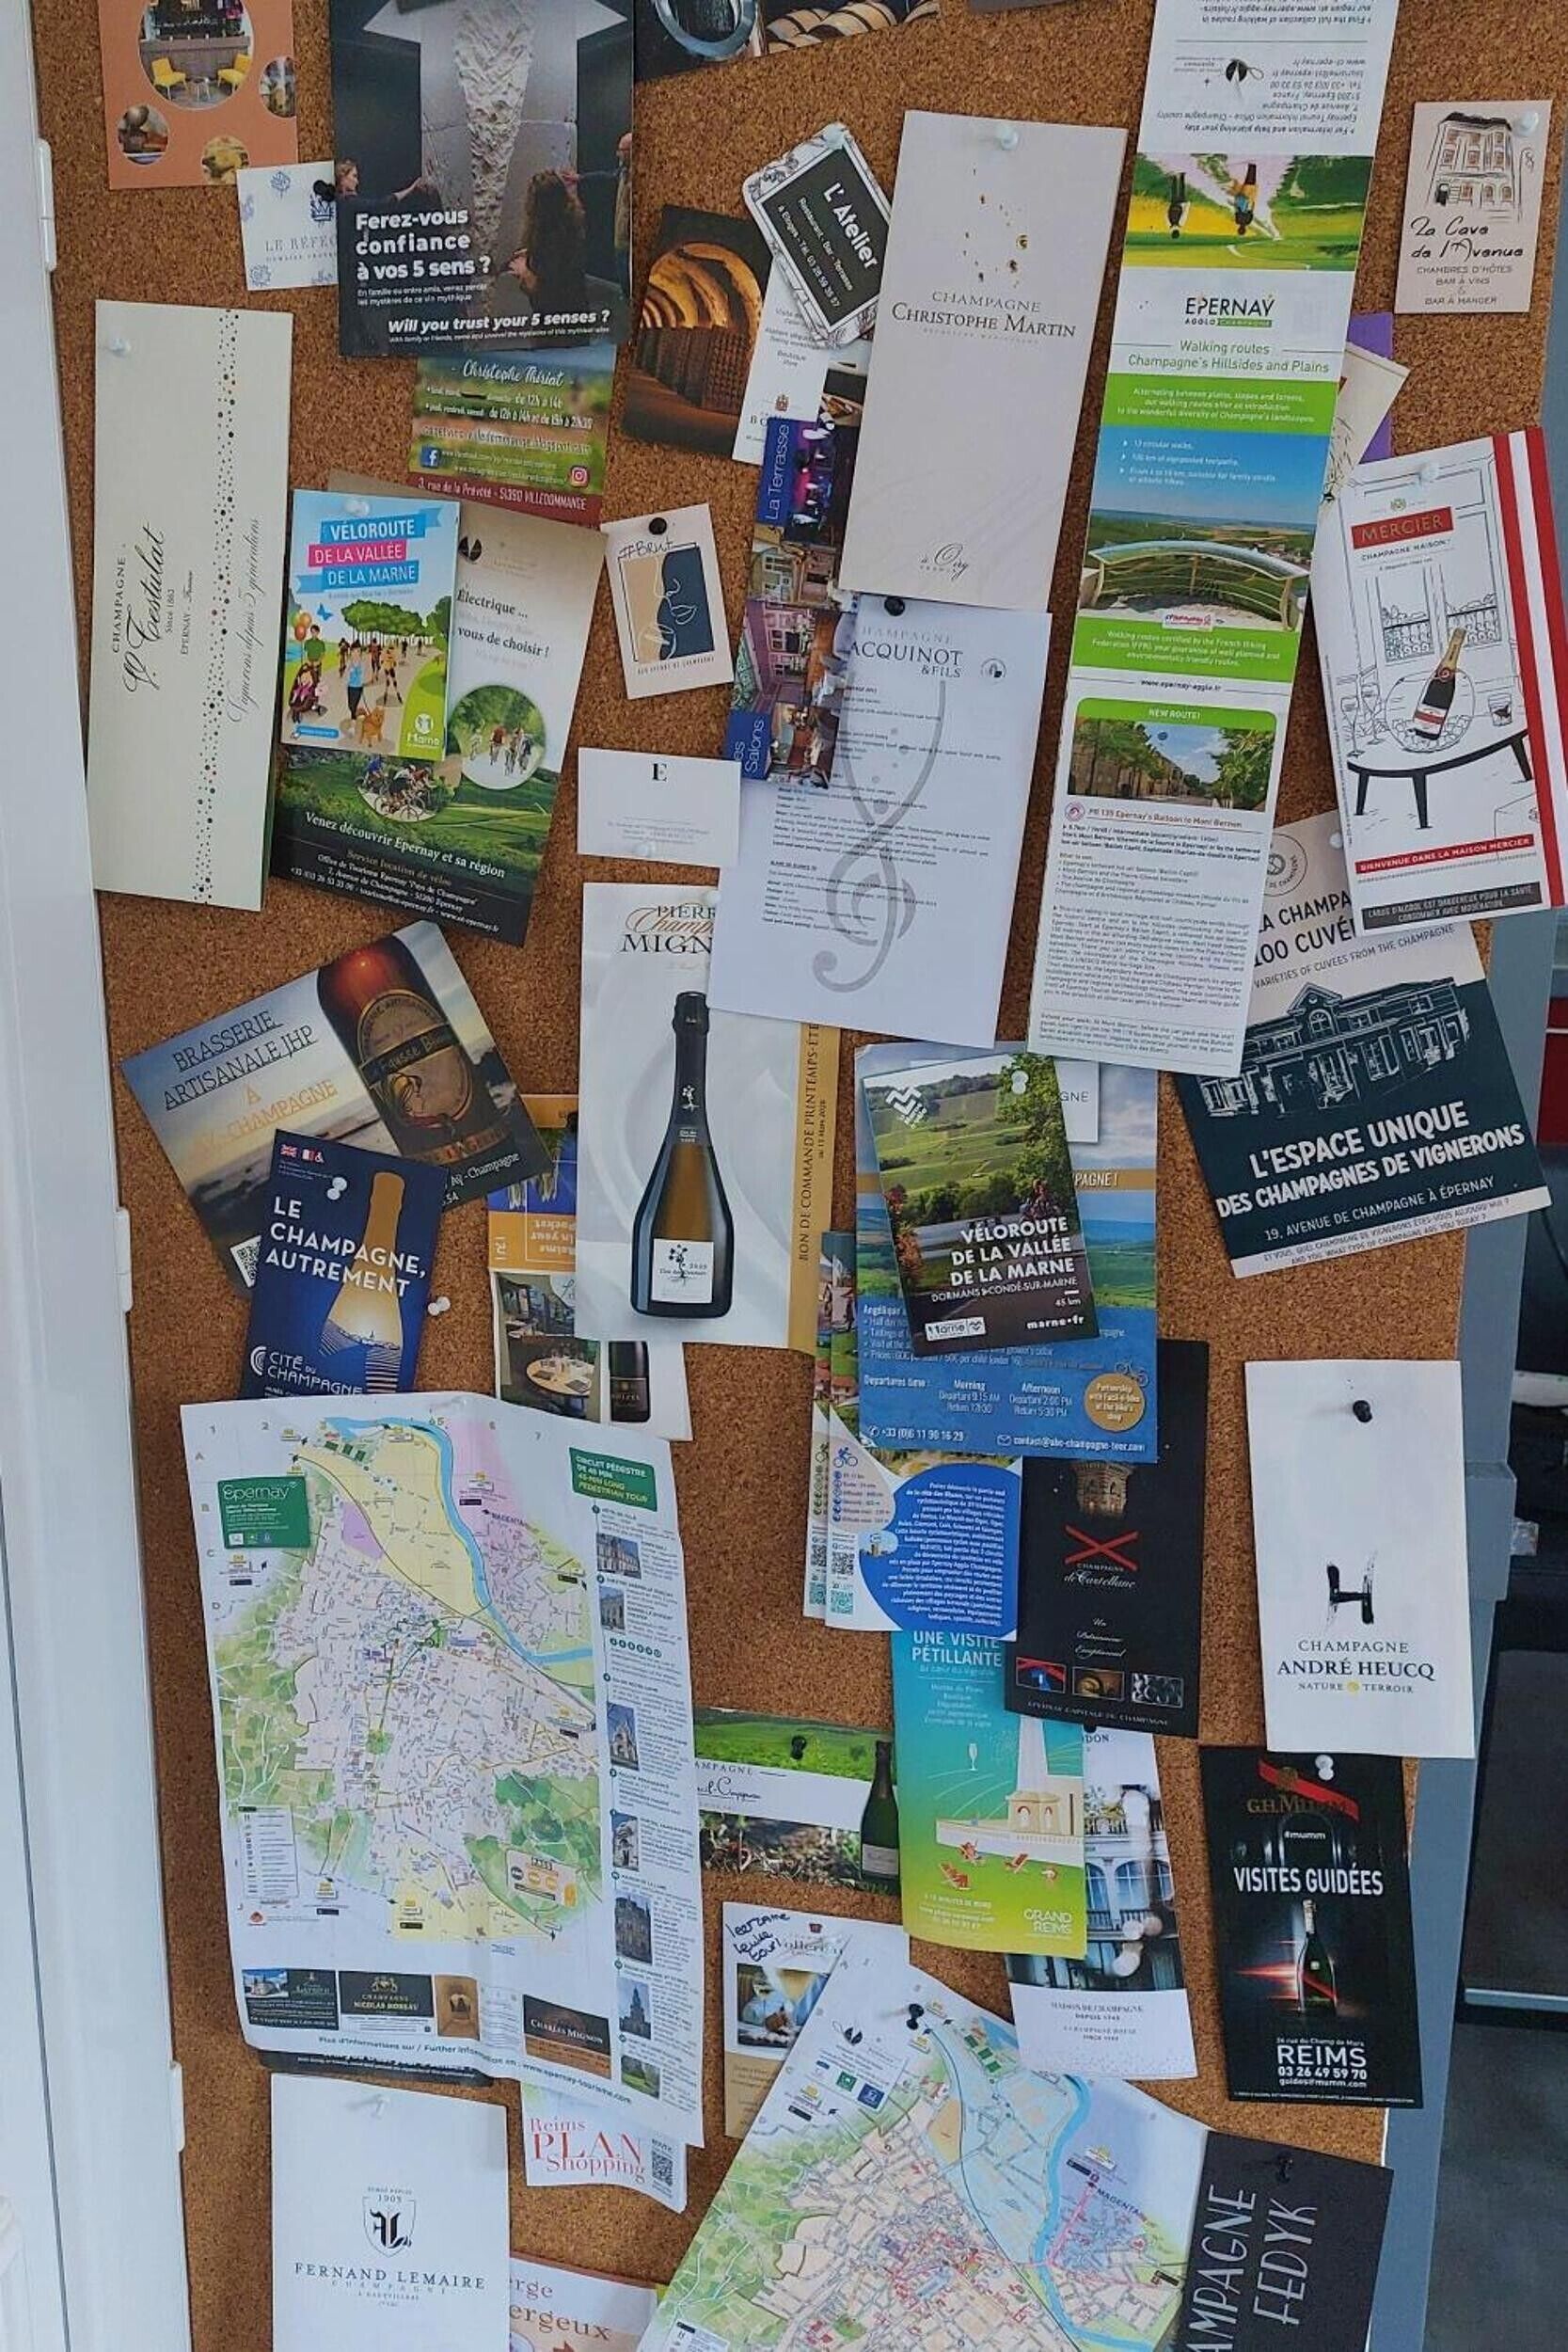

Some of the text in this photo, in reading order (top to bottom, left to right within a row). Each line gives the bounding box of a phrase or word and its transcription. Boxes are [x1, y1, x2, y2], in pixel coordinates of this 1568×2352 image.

[356, 209, 468, 230] Ferez-vous
[1444, 215, 1488, 236] Cave
[356, 233, 470, 255] confiance
[833, 202, 879, 269] Atelier
[1411, 245, 1432, 259] de
[356, 255, 491, 280] à vos 5 sens ?
[932, 291, 1042, 312] CHAMPAGNE
[1185, 294, 1275, 316] EPERNAY
[388, 310, 610, 334] Will you trust your 5 senses ?
[892, 301, 1076, 338] CHRISTOPHE MARTIN
[1180, 341, 1270, 355] Walking routes
[463, 358, 520, 382] Christophe
[1128, 355, 1329, 373] Champagne's Hillsides and Plains
[765, 423, 792, 521] La Terrasse
[428, 482, 461, 494] rue de la
[330, 517, 416, 541] VÉLOROUTE
[1360, 516, 1444, 542] MERCIER
[314, 542, 403, 564] DE LA VALLÉE
[327, 564, 416, 585] DE LA MARNE
[112, 557, 126, 655] CHAMPAGNE
[241, 612, 264, 650] depuis
[456, 625, 542, 656] vous de choisir
[1148, 708, 1168, 718] NEW
[744, 715, 765, 773] Salons
[651, 763, 668, 782] E
[306, 811, 505, 880] Venez découvrir et sa région
[1360, 837, 1531, 871] BIENVENUE DANS LA MAISON MERCIER
[380, 858, 416, 876] location
[1254, 969, 1299, 990] VARIETIES
[1301, 965, 1313, 978] OF
[1351, 948, 1375, 966] FROM
[1377, 943, 1397, 958] THE
[1398, 925, 1454, 947] CHAMPAGNE
[172, 1009, 278, 1073] BRASSERIE
[164, 1024, 317, 1111] ARTISANALE JHP
[1249, 1101, 1469, 1179] L'ESPACE UNIQUE
[800, 1128, 815, 1229] DE COMMANDE
[1216, 1124, 1526, 1218] DES CHAMPAGNES DE VIGNERONS
[274, 1196, 302, 1219] LE
[1287, 1175, 1495, 1237] AVENUE DE CHAMPAGNE ÉPERNAY
[960, 1216, 1068, 1244] VÉLOROUTE
[270, 1223, 426, 1279] CHAMPAGNE,
[951, 1235, 1071, 1267] DE LA VALLÉE
[265, 1248, 410, 1297] AUTREMENT
[950, 1257, 1075, 1287] DE LA MARNE
[931, 1288, 981, 1303] DORMANS
[1055, 1297, 1068, 1308] 45
[269, 1352, 317, 1375] CITÉ DU
[268, 1365, 363, 1395] CHAMPAGNE
[1021, 1383, 1062, 1395] Afternoon
[261, 1422, 270, 1431] 2
[913, 1630, 1001, 1649] UNE VISITE
[1297, 1639, 1410, 1654] CHAMPAGNE
[911, 1643, 1003, 1667] PÉTILLANTE
[1277, 1657, 1435, 1681] ANDRÉ HEUCQ
[1297, 1682, 1414, 1693] NATURE TERROIR
[1284, 1829, 1326, 1841] #mumm
[1233, 1862, 1384, 1896] VISITES GUIDÉES
[1023, 1908, 1072, 1923] GRAND
[1034, 1922, 1072, 1934] REIMS
[424, 2044, 456, 2053] Further
[1277, 2044, 1367, 2067] REIMS
[1278, 2066, 1367, 2079] 03 26 49 59 70
[530, 2116, 587, 2133] Reims
[533, 2131, 641, 2164] PLAN
[546, 2153, 646, 2185] Shopping
[1254, 2198, 1318, 2326] FEDYK
[293, 2262, 486, 2291] FERNAND LEMAIRE
